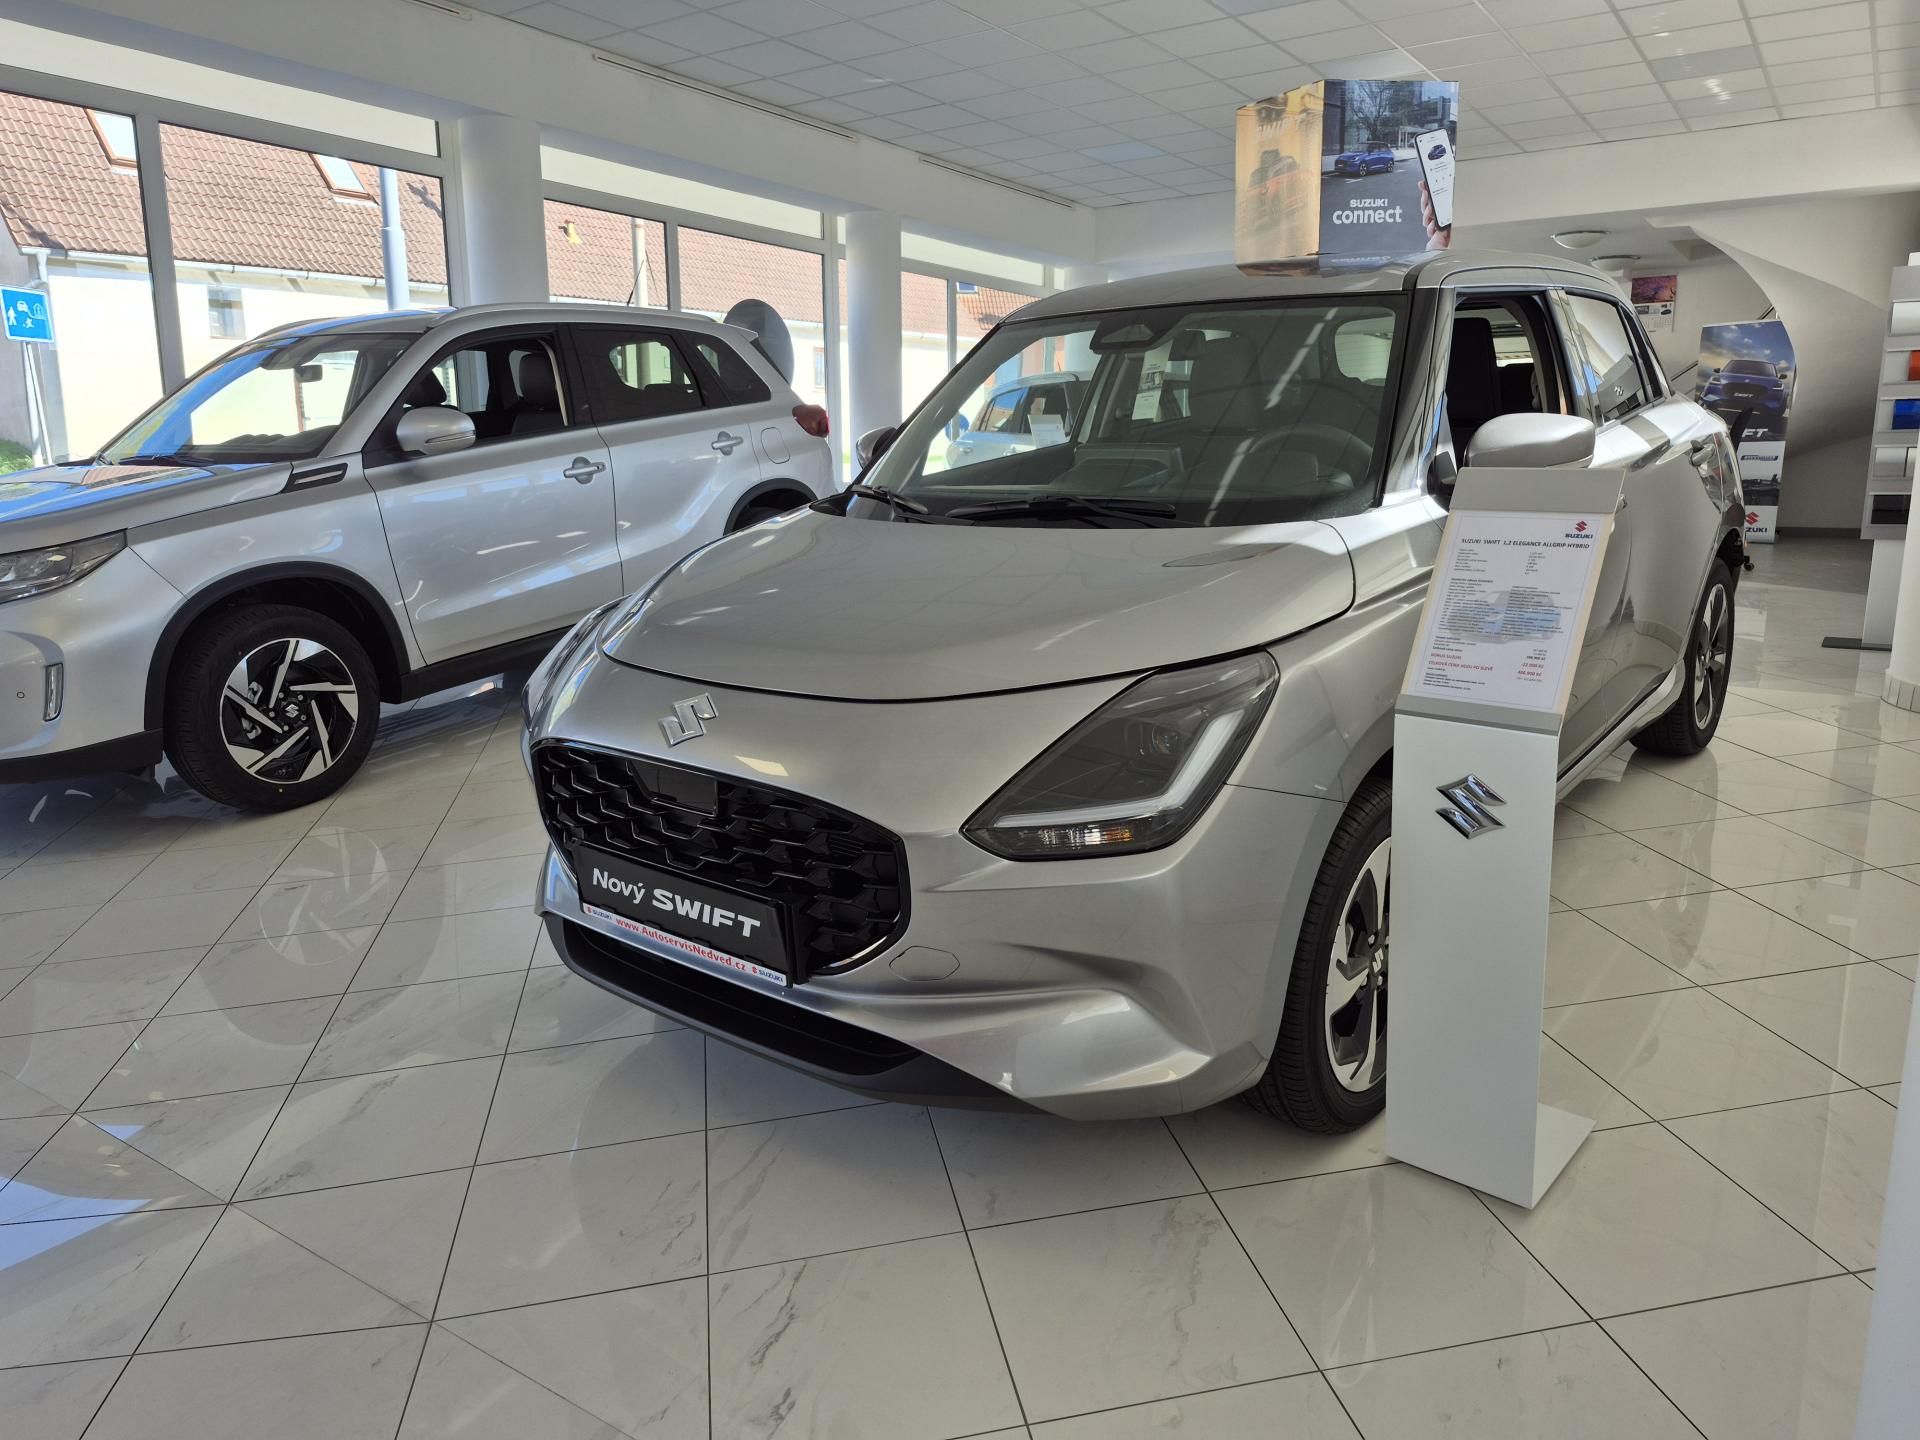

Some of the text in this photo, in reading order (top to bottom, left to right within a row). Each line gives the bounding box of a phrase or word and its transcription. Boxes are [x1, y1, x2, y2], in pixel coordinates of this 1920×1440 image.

[1332, 206, 1403, 225] connect
[1349, 198, 1389, 208] SUZUKI
[592, 867, 761, 938] Nový SWIFT
[615, 917, 746, 971] www.AutoservisNedved.cz
[758, 968, 784, 983] SUZUKI
